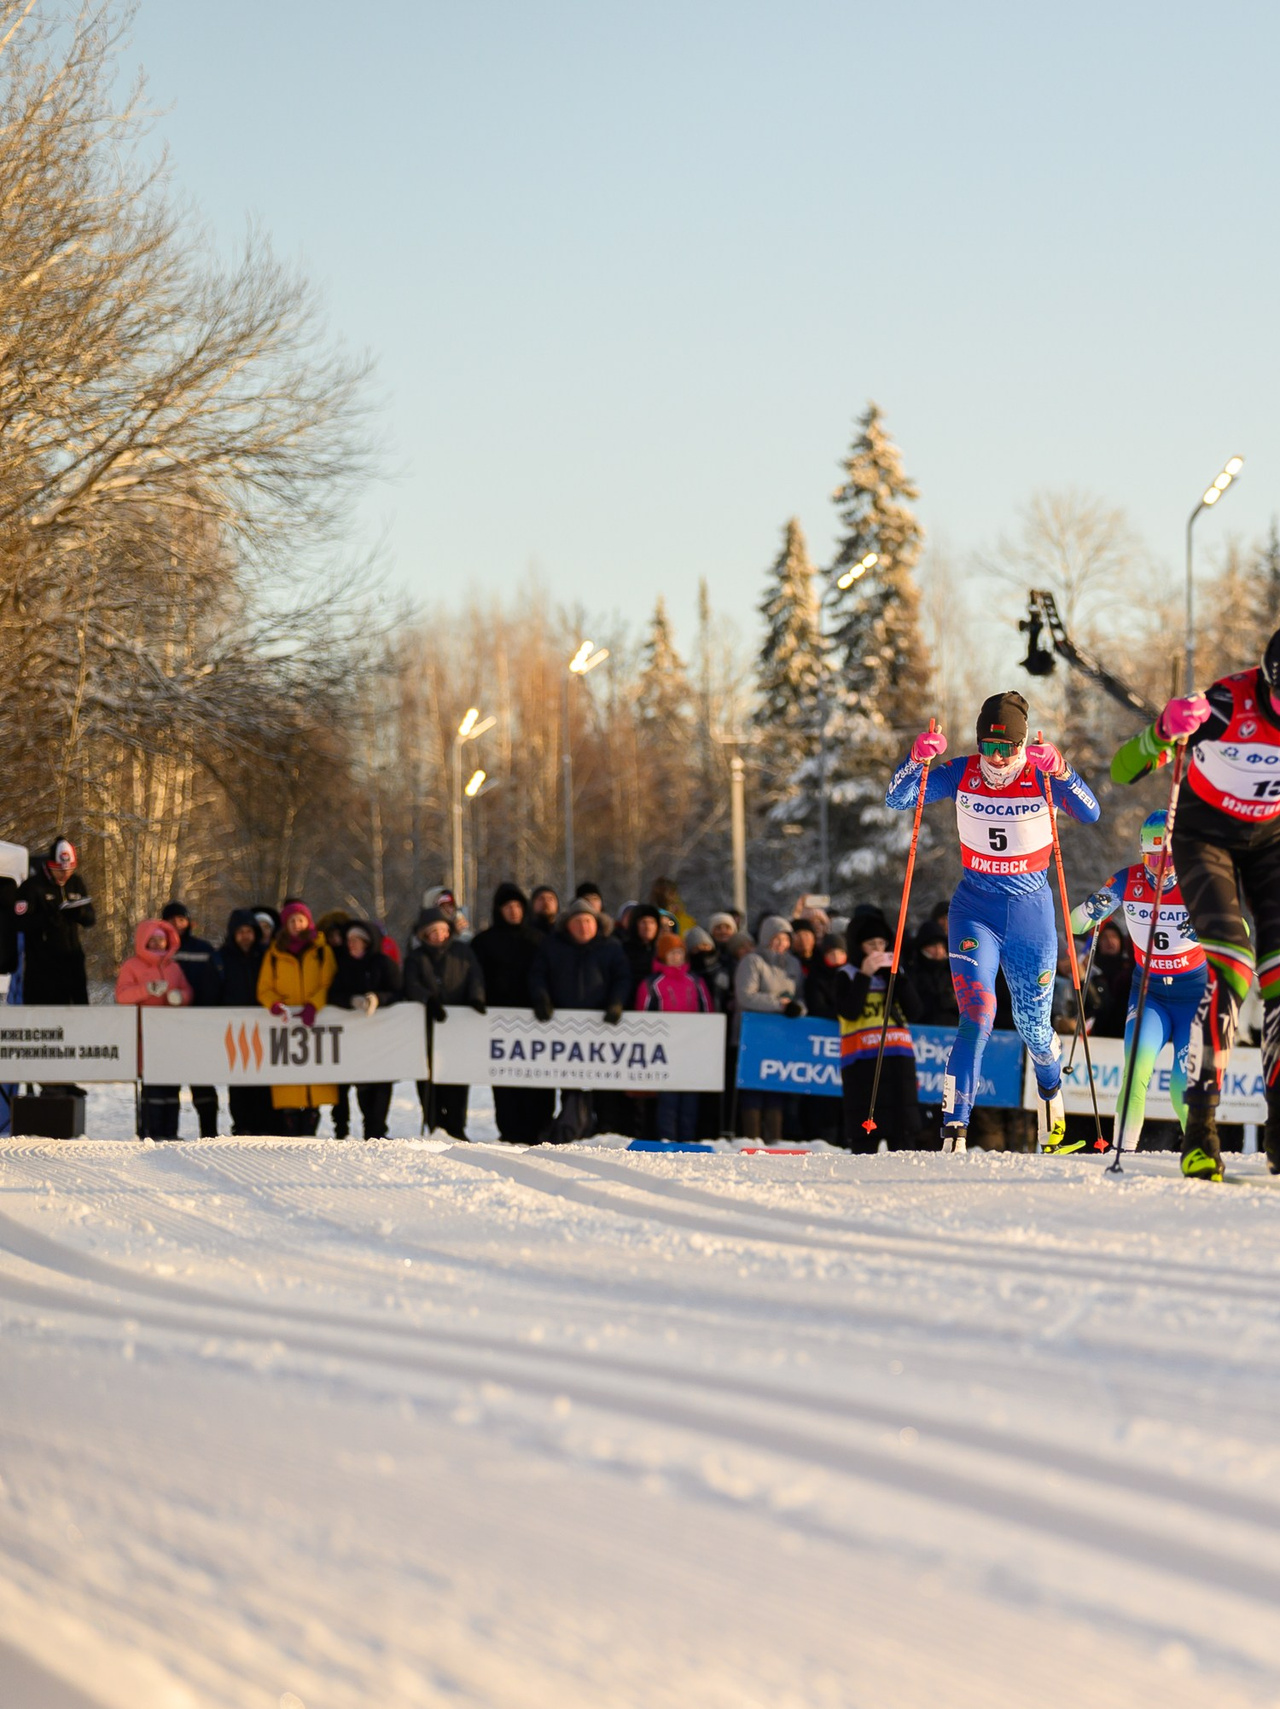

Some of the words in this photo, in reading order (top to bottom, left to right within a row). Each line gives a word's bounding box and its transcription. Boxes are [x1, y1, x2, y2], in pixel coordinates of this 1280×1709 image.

[972, 802, 1041, 816] ФОСАГРО
[988, 827, 1008, 852] 5
[970, 855, 1029, 875] ИЖЕВСК
[1153, 931, 1170, 951] 6
[0, 1026, 64, 1041] ИЖЕВСКИЙ
[78, 1045, 120, 1060] ЗАВОД
[269, 1024, 344, 1067] ИЗТТ
[488, 1038, 669, 1069] БАРРАКУДА
